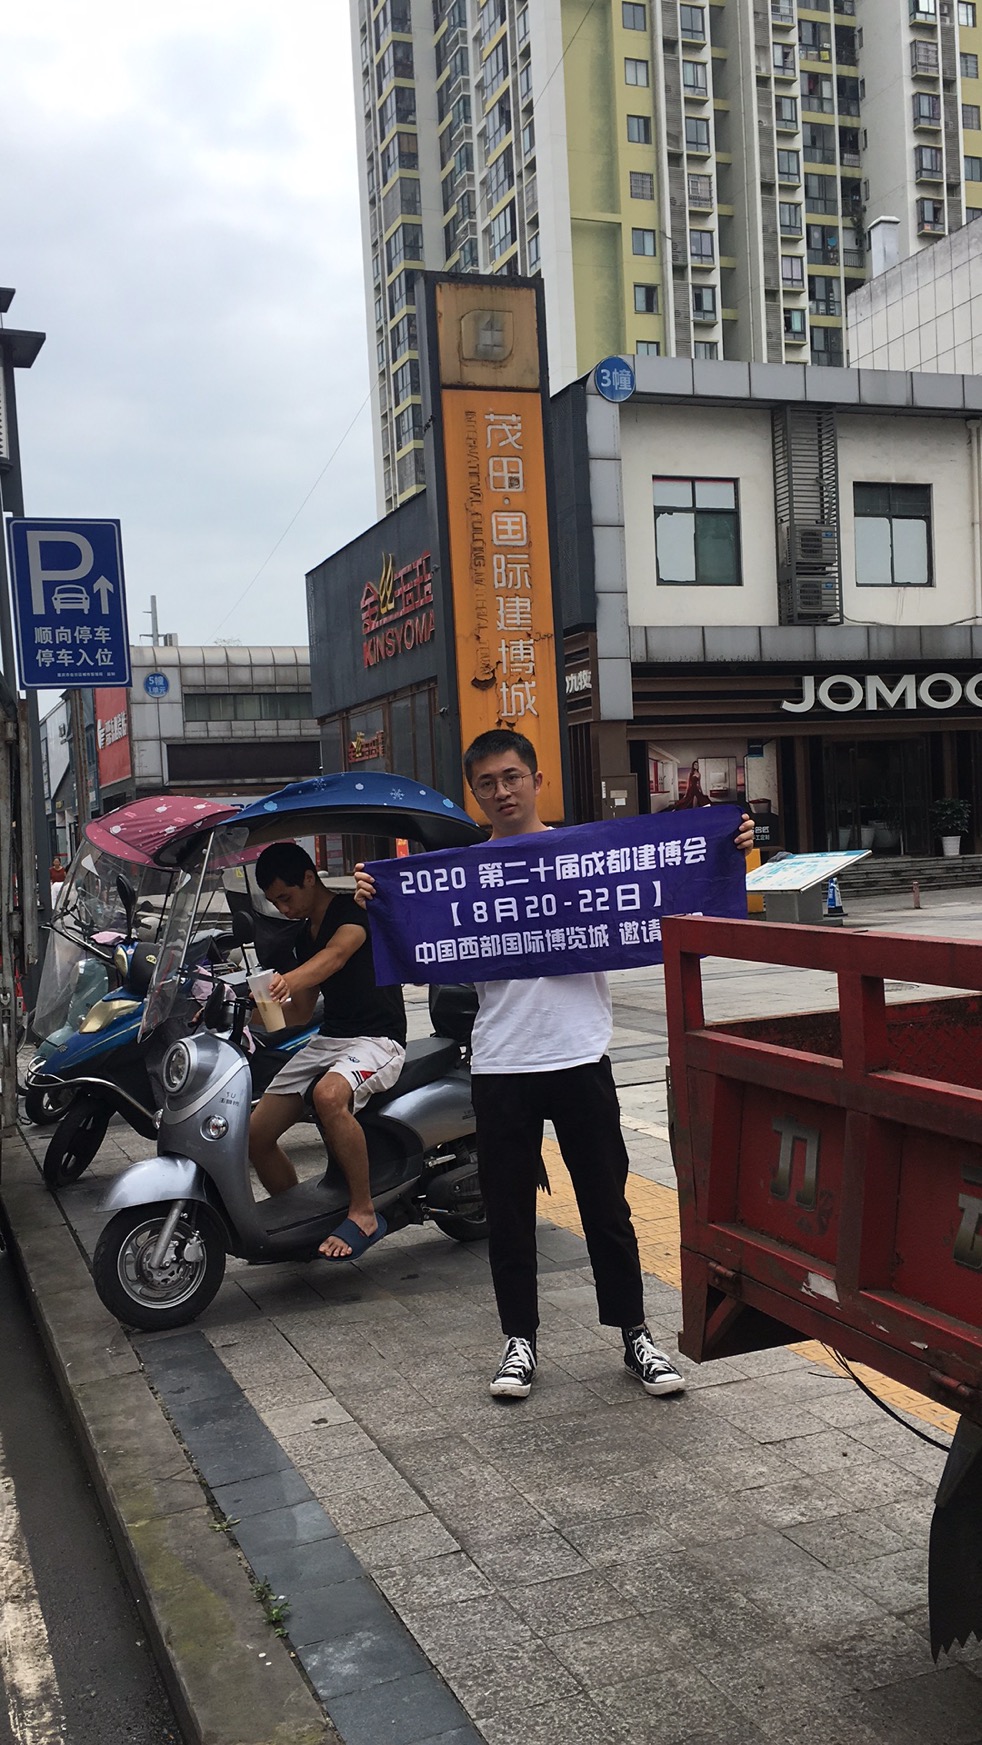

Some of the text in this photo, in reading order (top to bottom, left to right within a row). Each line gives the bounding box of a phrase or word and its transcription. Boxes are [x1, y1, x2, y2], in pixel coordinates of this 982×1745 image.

[600, 368, 632, 390] 3幢
[26, 530, 94, 615] P
[34, 626, 112, 645] 顺向停车
[363, 609, 436, 669] KINSYOMA
[35, 648, 114, 668] 停车入位
[399, 866, 467, 895] 2020
[478, 836, 707, 889] 第二十届成都建博会
[415, 924, 610, 964] 中国西部国际博览城
